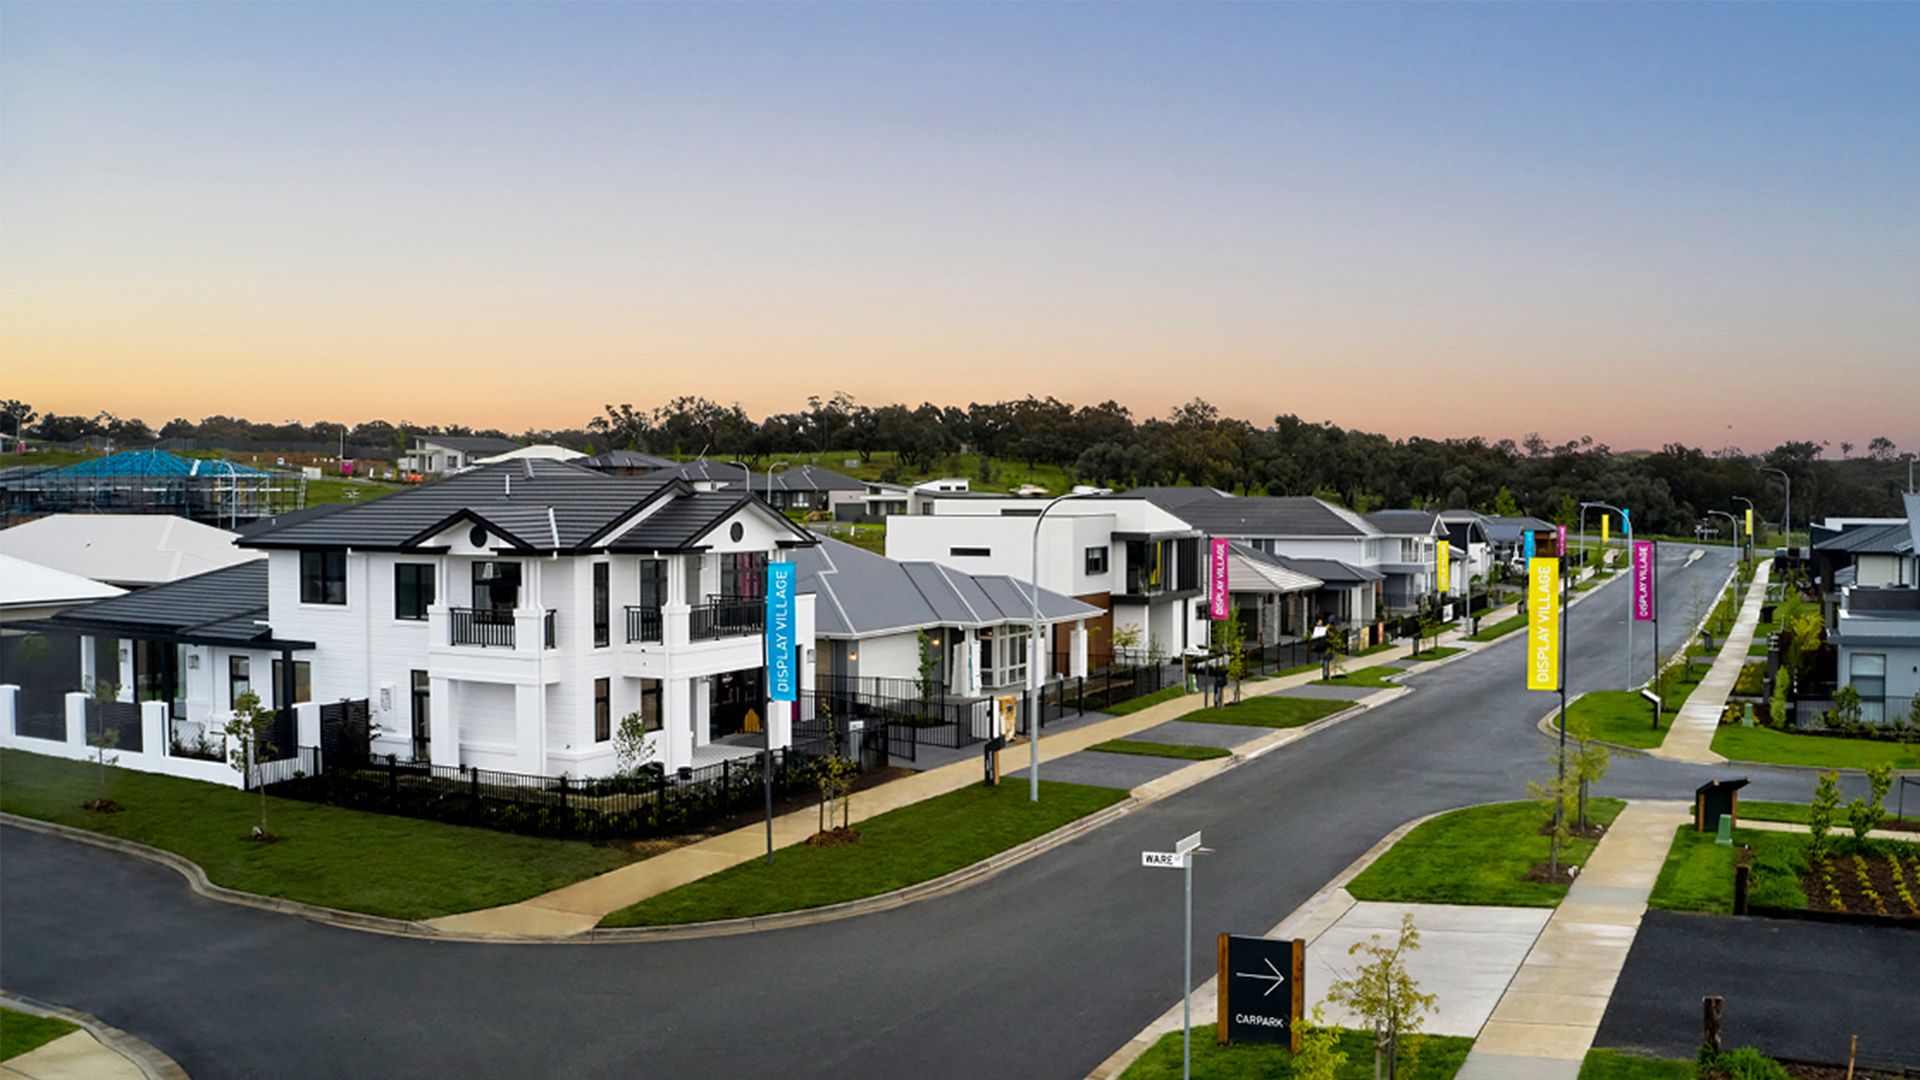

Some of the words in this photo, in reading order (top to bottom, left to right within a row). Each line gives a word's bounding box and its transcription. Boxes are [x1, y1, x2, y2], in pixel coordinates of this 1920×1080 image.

[1216, 544, 1225, 579] VILLAGE
[1639, 546, 1648, 580] VILLAGE
[776, 571, 788, 631] VILLAGE
[1215, 580, 1225, 616] DISPLAY
[1537, 566, 1551, 622] VILLAGE
[1639, 580, 1648, 617] DISPLAY
[776, 635, 789, 693] DISPLAY
[1537, 625, 1550, 683] DISPLAY
[1145, 854, 1173, 866] WARE
[1235, 1013, 1285, 1028] CARPARK
